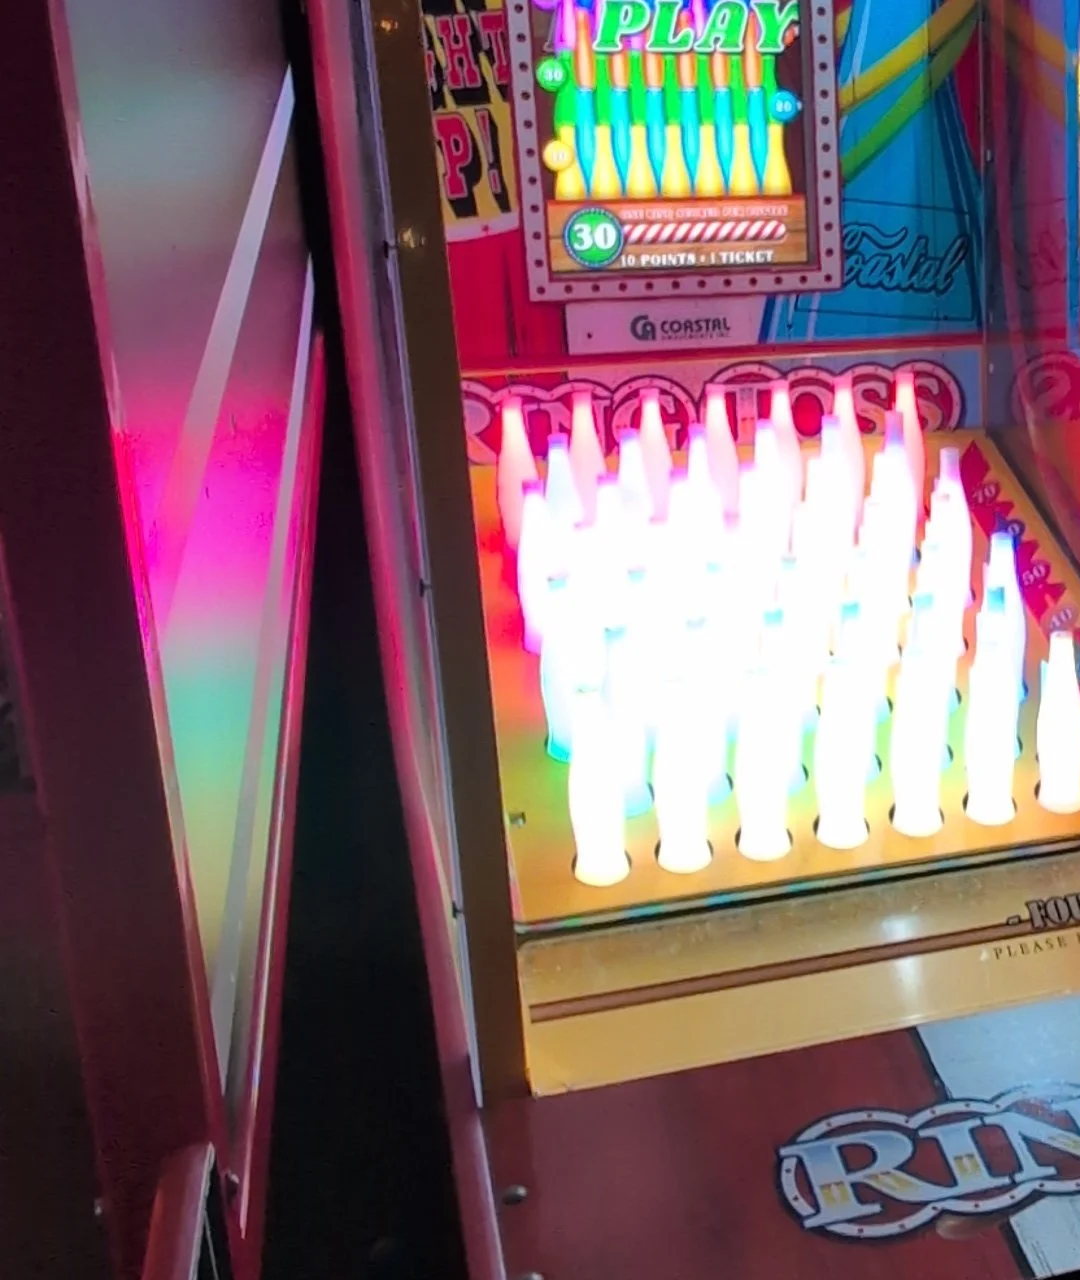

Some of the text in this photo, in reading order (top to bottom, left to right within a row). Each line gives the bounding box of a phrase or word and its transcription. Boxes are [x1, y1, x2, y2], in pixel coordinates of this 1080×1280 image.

[574, 223, 617, 250] 30
[621, 254, 634, 267] 10
[641, 253, 696, 267] POINTS
[720, 250, 775, 265] TICKET
[661, 317, 731, 334] COASTAL
[972, 484, 997, 505] 70
[1021, 563, 1046, 587] 50
[993, 934, 1069, 960] PLEASE
